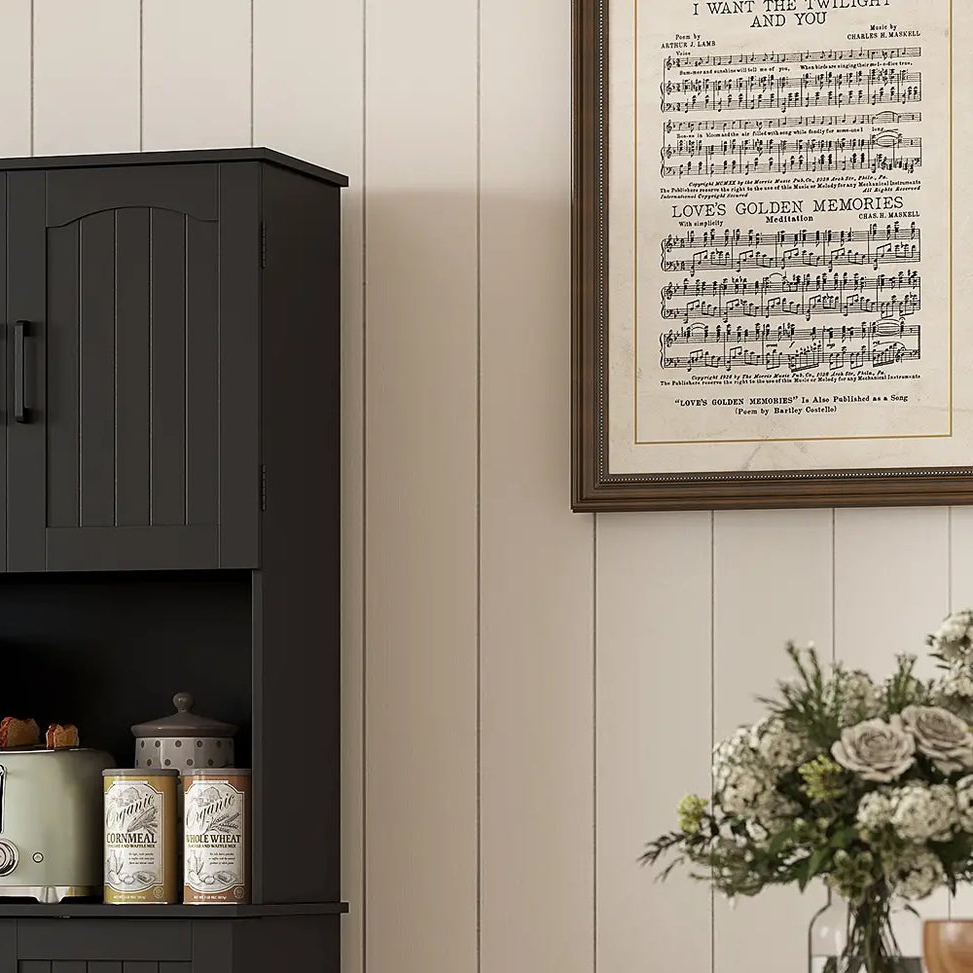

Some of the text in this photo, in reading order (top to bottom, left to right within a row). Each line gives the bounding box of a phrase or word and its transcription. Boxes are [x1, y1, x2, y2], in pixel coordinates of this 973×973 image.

[693, 3, 699, 15] I
[707, 1, 755, 14] WANT
[763, 0, 797, 12] THE
[750, 11, 827, 28] AND YOU
[890, 24, 897, 32] by
[847, 30, 921, 40] CHARLES H. MASKELL
[672, 196, 904, 218] LOVE'S GOLDEN MEMORIES
[766, 215, 814, 223] Meditation
[859, 212, 878, 220] CHAS.
[888, 211, 920, 219] MASKELL
[694, 220, 723, 228] simplicity
[711, 397, 744, 406] GOLDEN
[833, 395, 870, 403] Published
[890, 394, 908, 403] Song
[735, 406, 837, 416] (Poem by Bartley Costello)
[106, 833, 157, 844] CORNMEAL
[186, 834, 241, 844] WHOLE WHEAT
